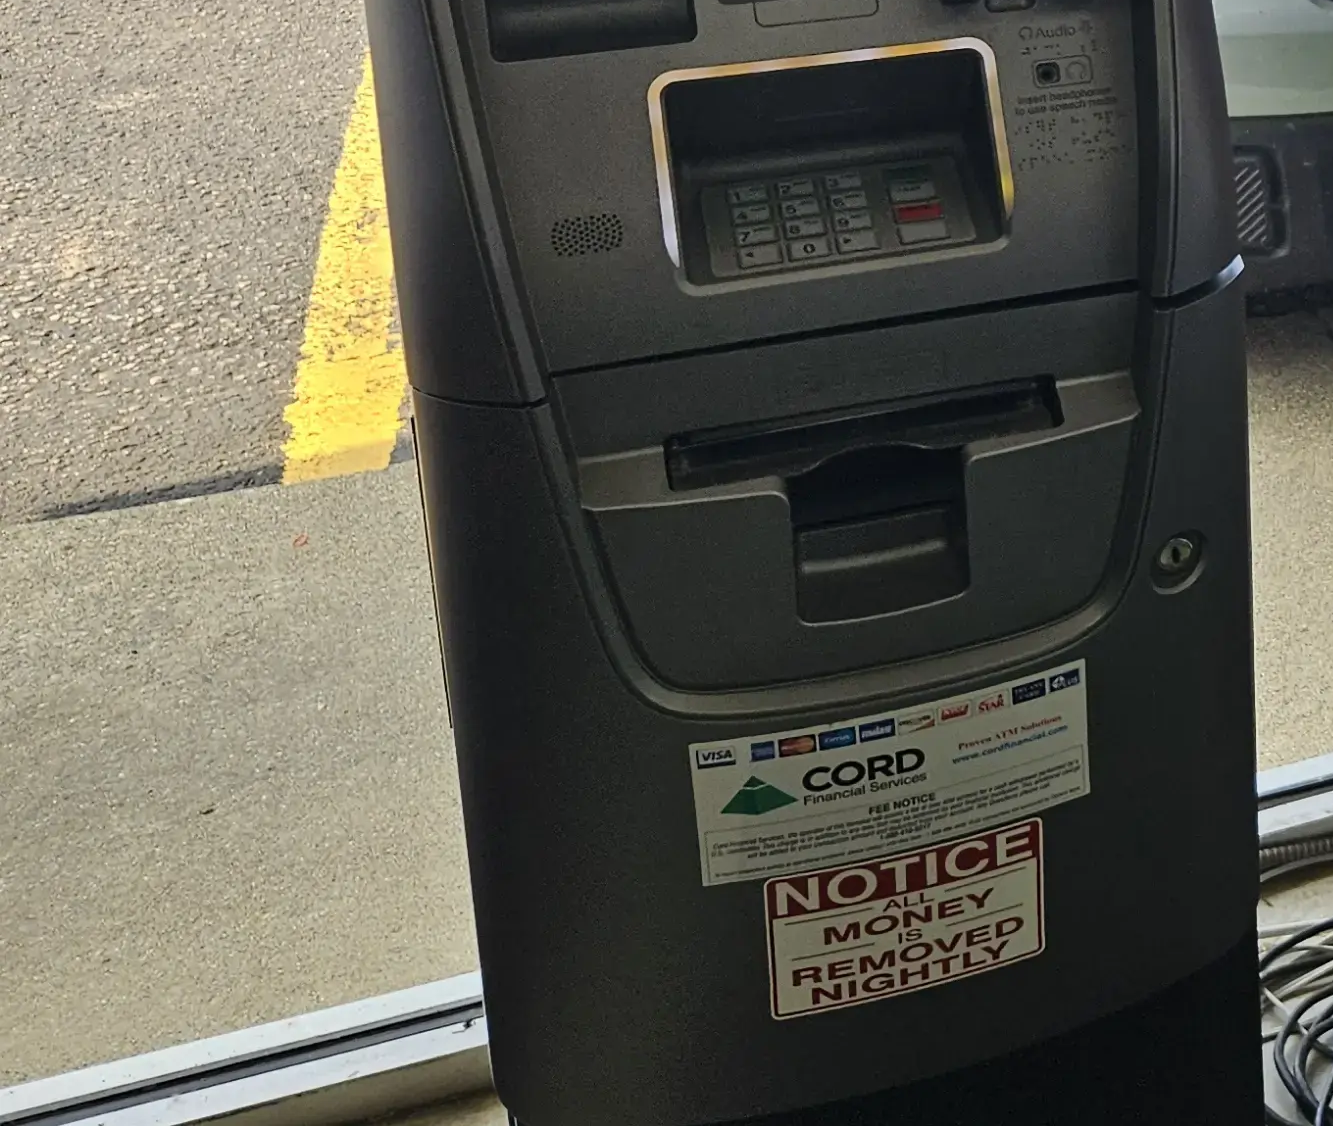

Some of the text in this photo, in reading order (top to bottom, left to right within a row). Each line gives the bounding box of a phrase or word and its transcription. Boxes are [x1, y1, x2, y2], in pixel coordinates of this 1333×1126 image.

[1035, 25, 1076, 39] Audio
[952, 724, 1068, 765] www.cordfinancial.com
[958, 715, 1062, 751] Proven ATM Solutions
[701, 749, 733, 762] VISA
[801, 748, 925, 792] CORD
[803, 772, 927, 806] Financial Services
[868, 792, 936, 815] FEE NOTICE
[775, 825, 1033, 916] NOTICE
[824, 887, 994, 946] MONEY
[882, 891, 935, 912] ALL
[791, 916, 1025, 987] REMOVED
[897, 928, 923, 944] IS
[811, 939, 1010, 1005] NIGHTLY
